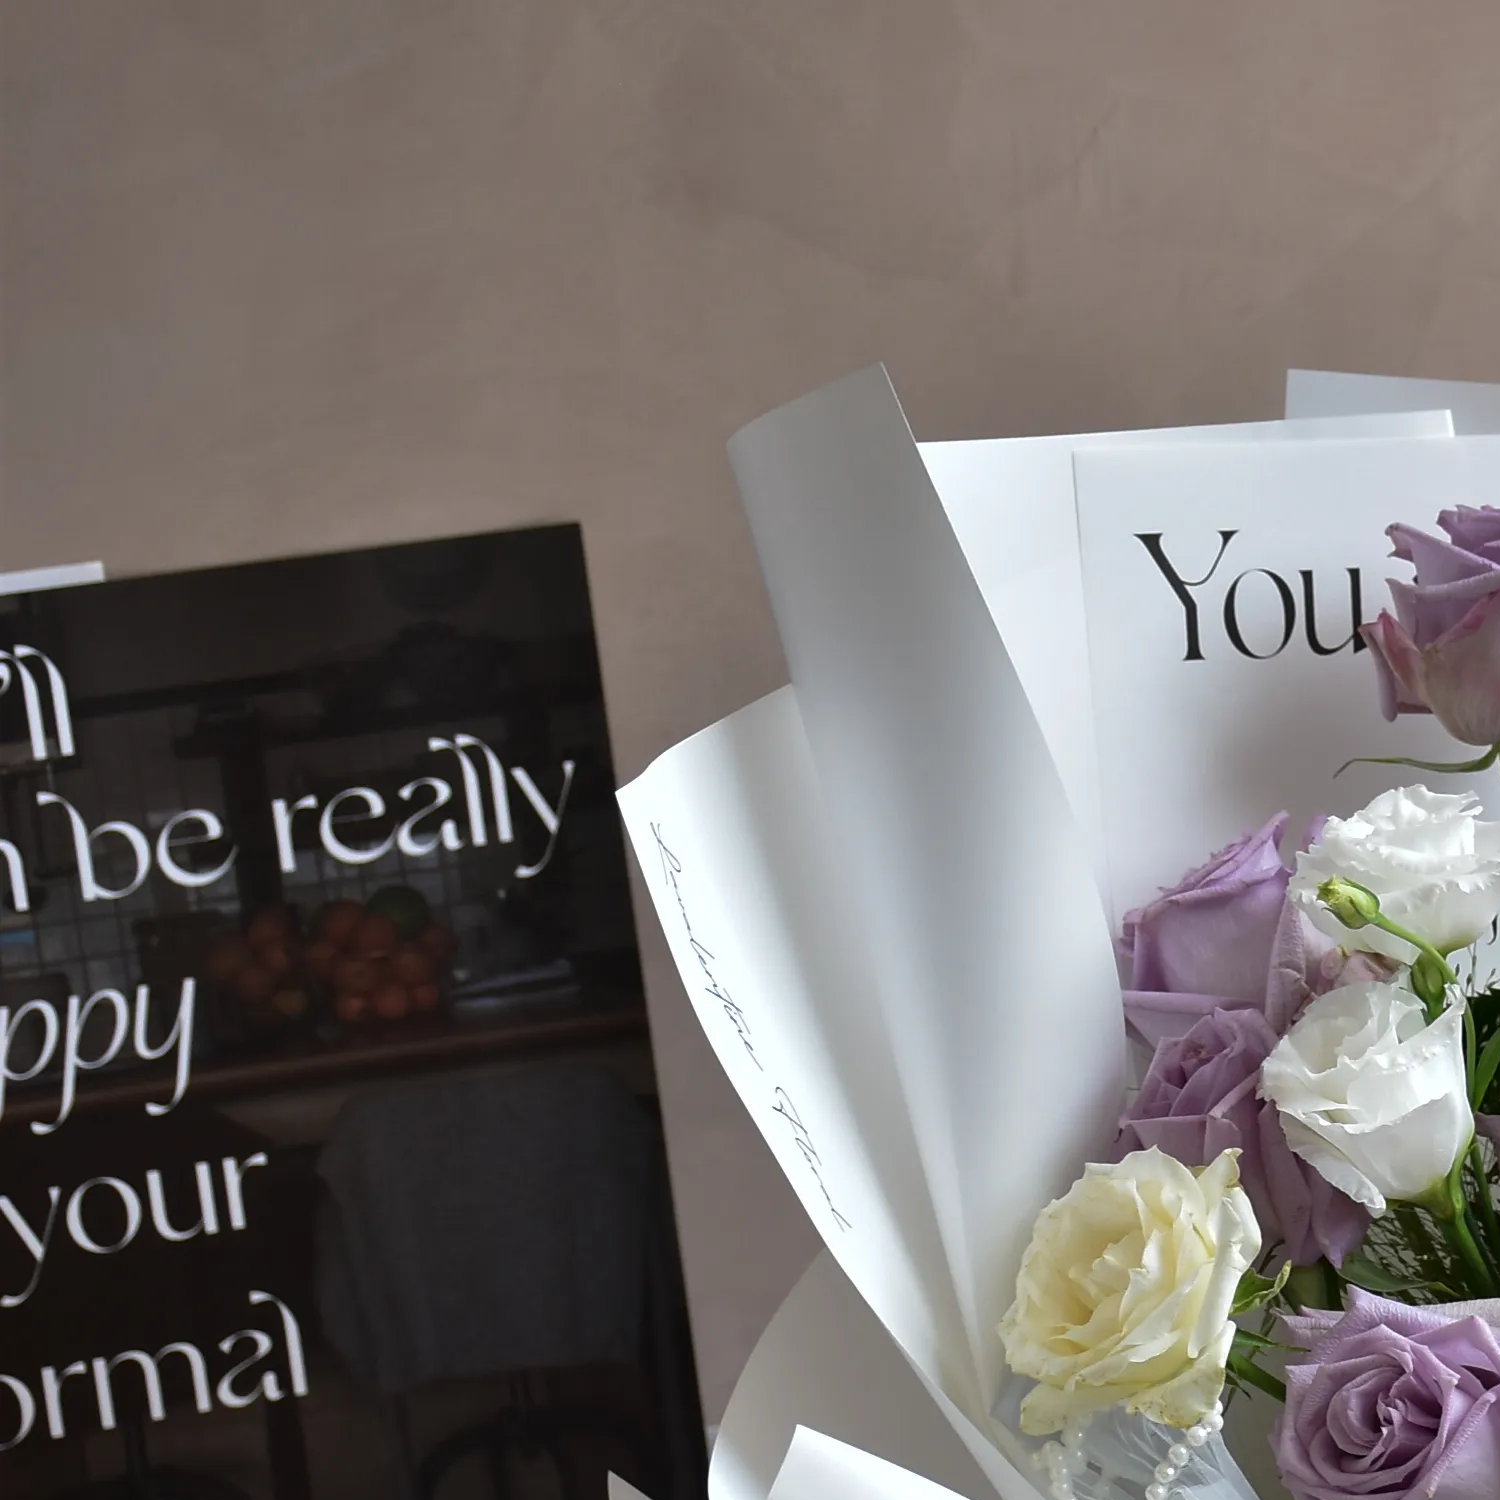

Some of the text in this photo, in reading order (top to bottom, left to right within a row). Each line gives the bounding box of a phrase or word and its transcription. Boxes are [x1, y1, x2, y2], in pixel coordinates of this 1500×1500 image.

[1133, 529, 1367, 661] You
[36, 791, 239, 901] be
[271, 733, 576, 878] really
[0, 1152, 268, 1308] your
